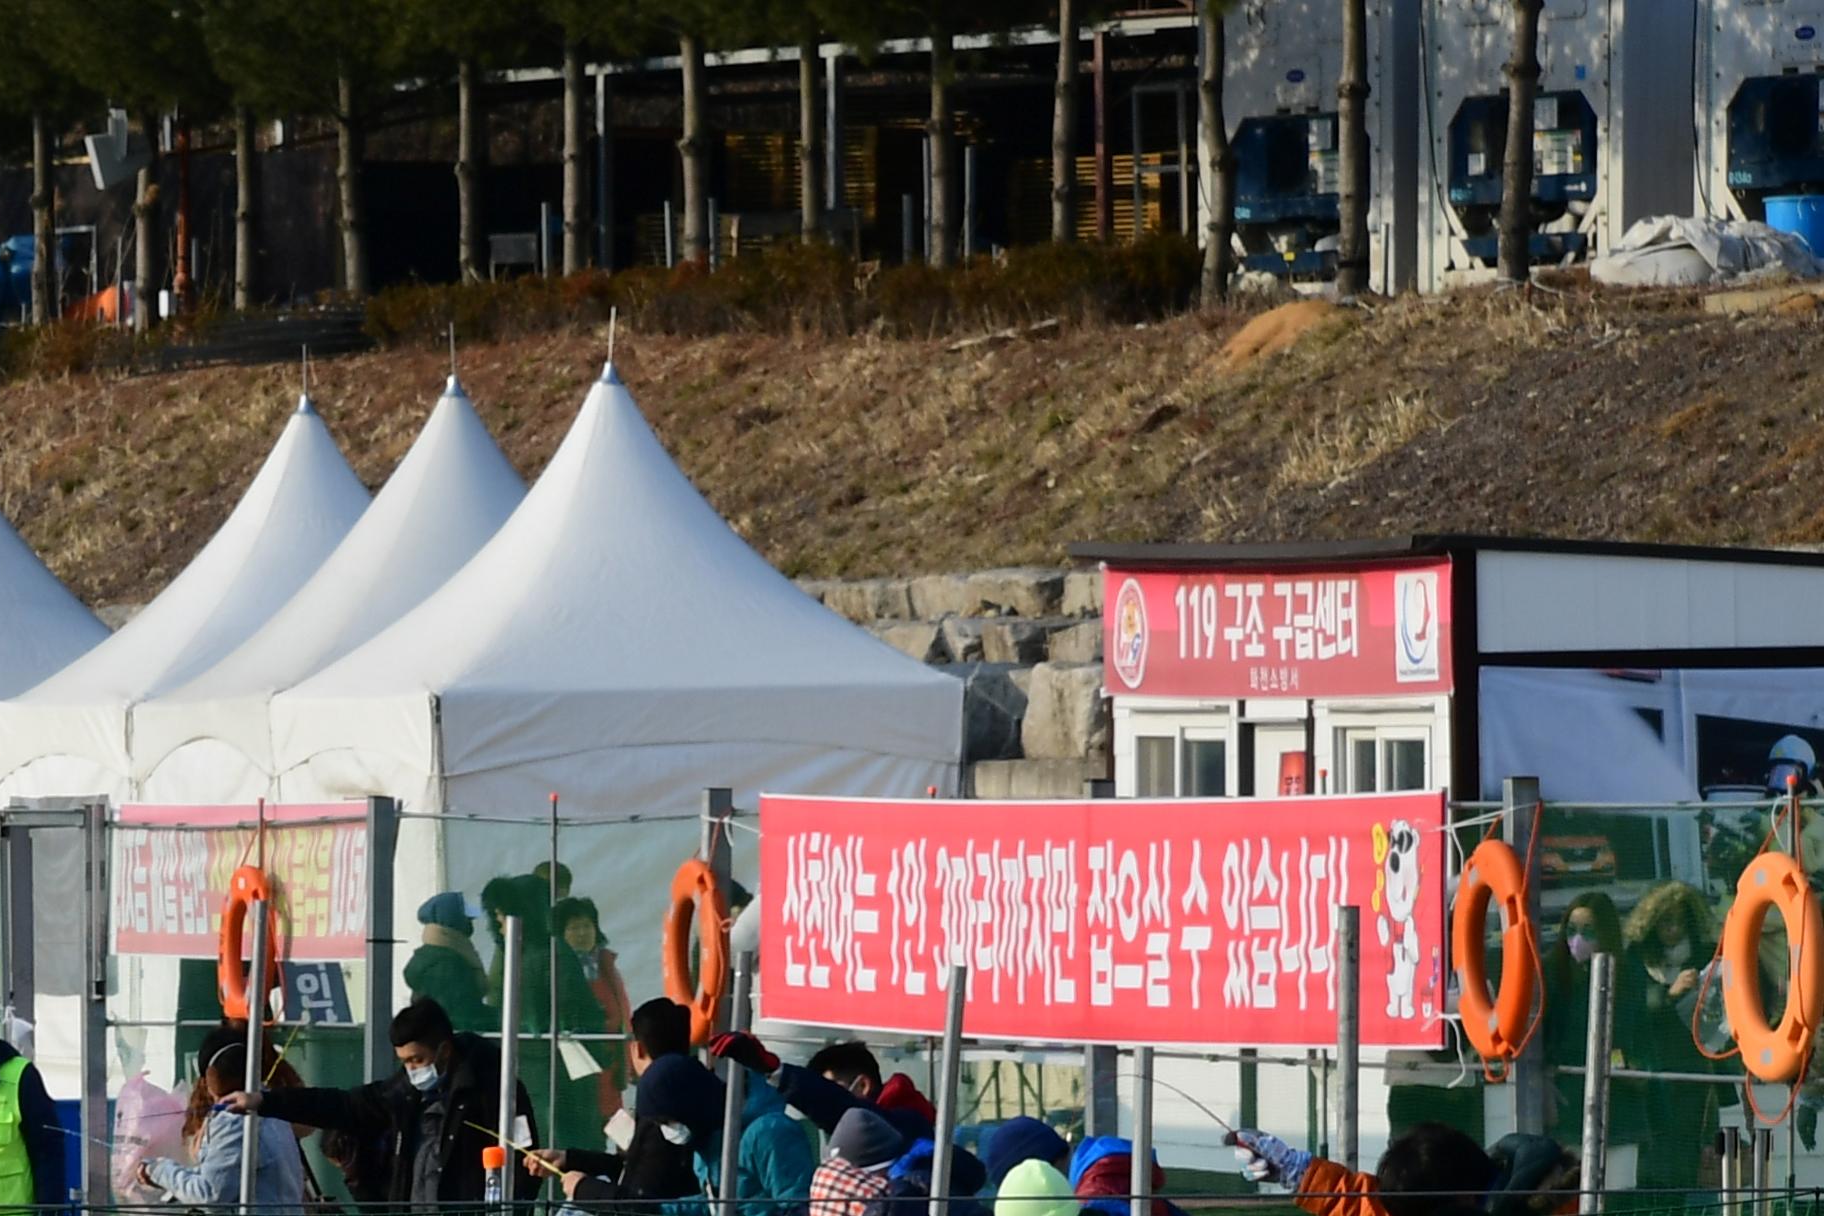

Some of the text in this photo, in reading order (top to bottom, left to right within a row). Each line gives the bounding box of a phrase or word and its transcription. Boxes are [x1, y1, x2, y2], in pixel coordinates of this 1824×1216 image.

[1175, 579, 1359, 662] 119 구조 구급센터
[1249, 666, 1300, 692] 화천소방서
[782, 831, 879, 994] 산천어는
[887, 837, 927, 996] 1인
[933, 838, 1079, 1007] 3마리까지만
[1087, 839, 1172, 1008] 잡으실
[1181, 839, 1213, 1010] 수
